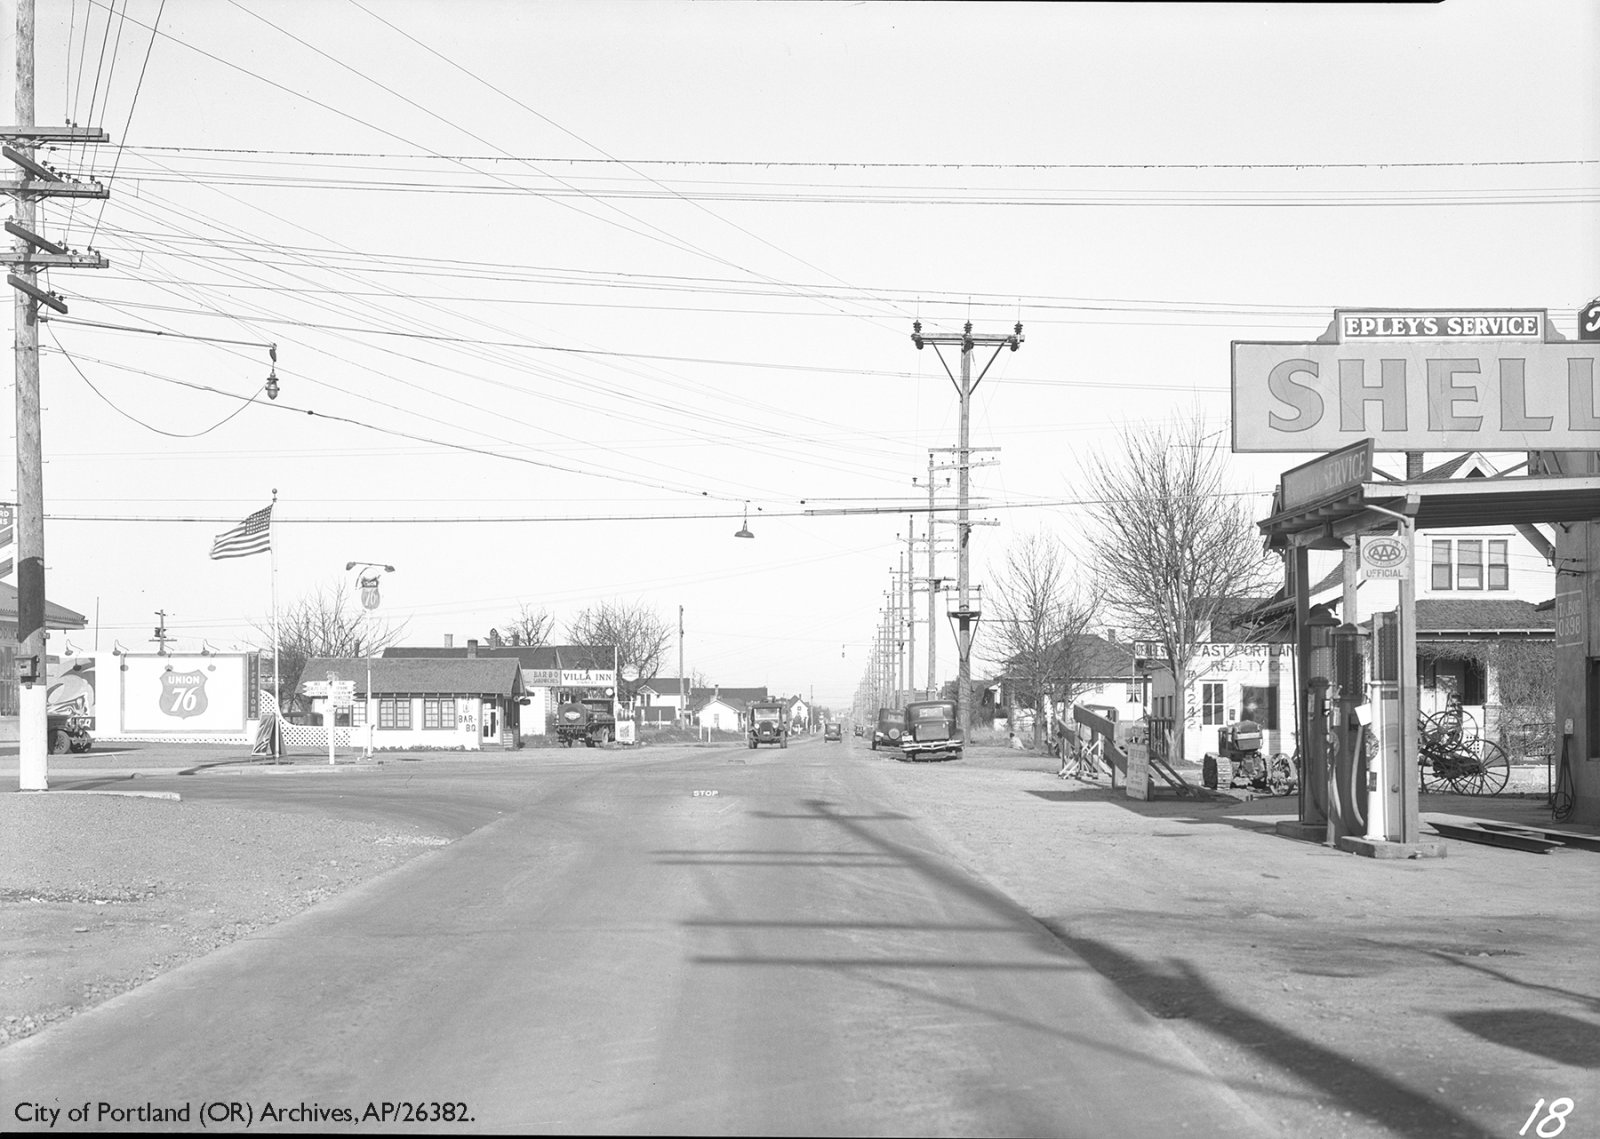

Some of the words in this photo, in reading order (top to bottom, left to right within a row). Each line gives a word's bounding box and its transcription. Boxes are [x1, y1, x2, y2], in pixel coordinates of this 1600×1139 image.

[1346, 316, 1439, 336] EPLEY'S
[1447, 316, 1537, 335] SERVICE
[1268, 357, 1600, 433] SHELL
[1324, 450, 1366, 491] SERVICE
[1372, 544, 1398, 561] AAA
[1366, 568, 1404, 578] OFFICIAL
[1558, 615, 1581, 638] 0398
[1194, 644, 1230, 658] EAST
[1235, 644, 1299, 658] PORTLAN
[1211, 659, 1266, 673] REALTY
[168, 675, 200, 685] UNION
[563, 673, 592, 681] VILLA
[595, 673, 612, 681] INN
[170, 686, 200, 712] 76
[465, 723, 476, 733] BQ
[692, 789, 719, 797] STOP
[1518, 1096, 1575, 1139] 18
